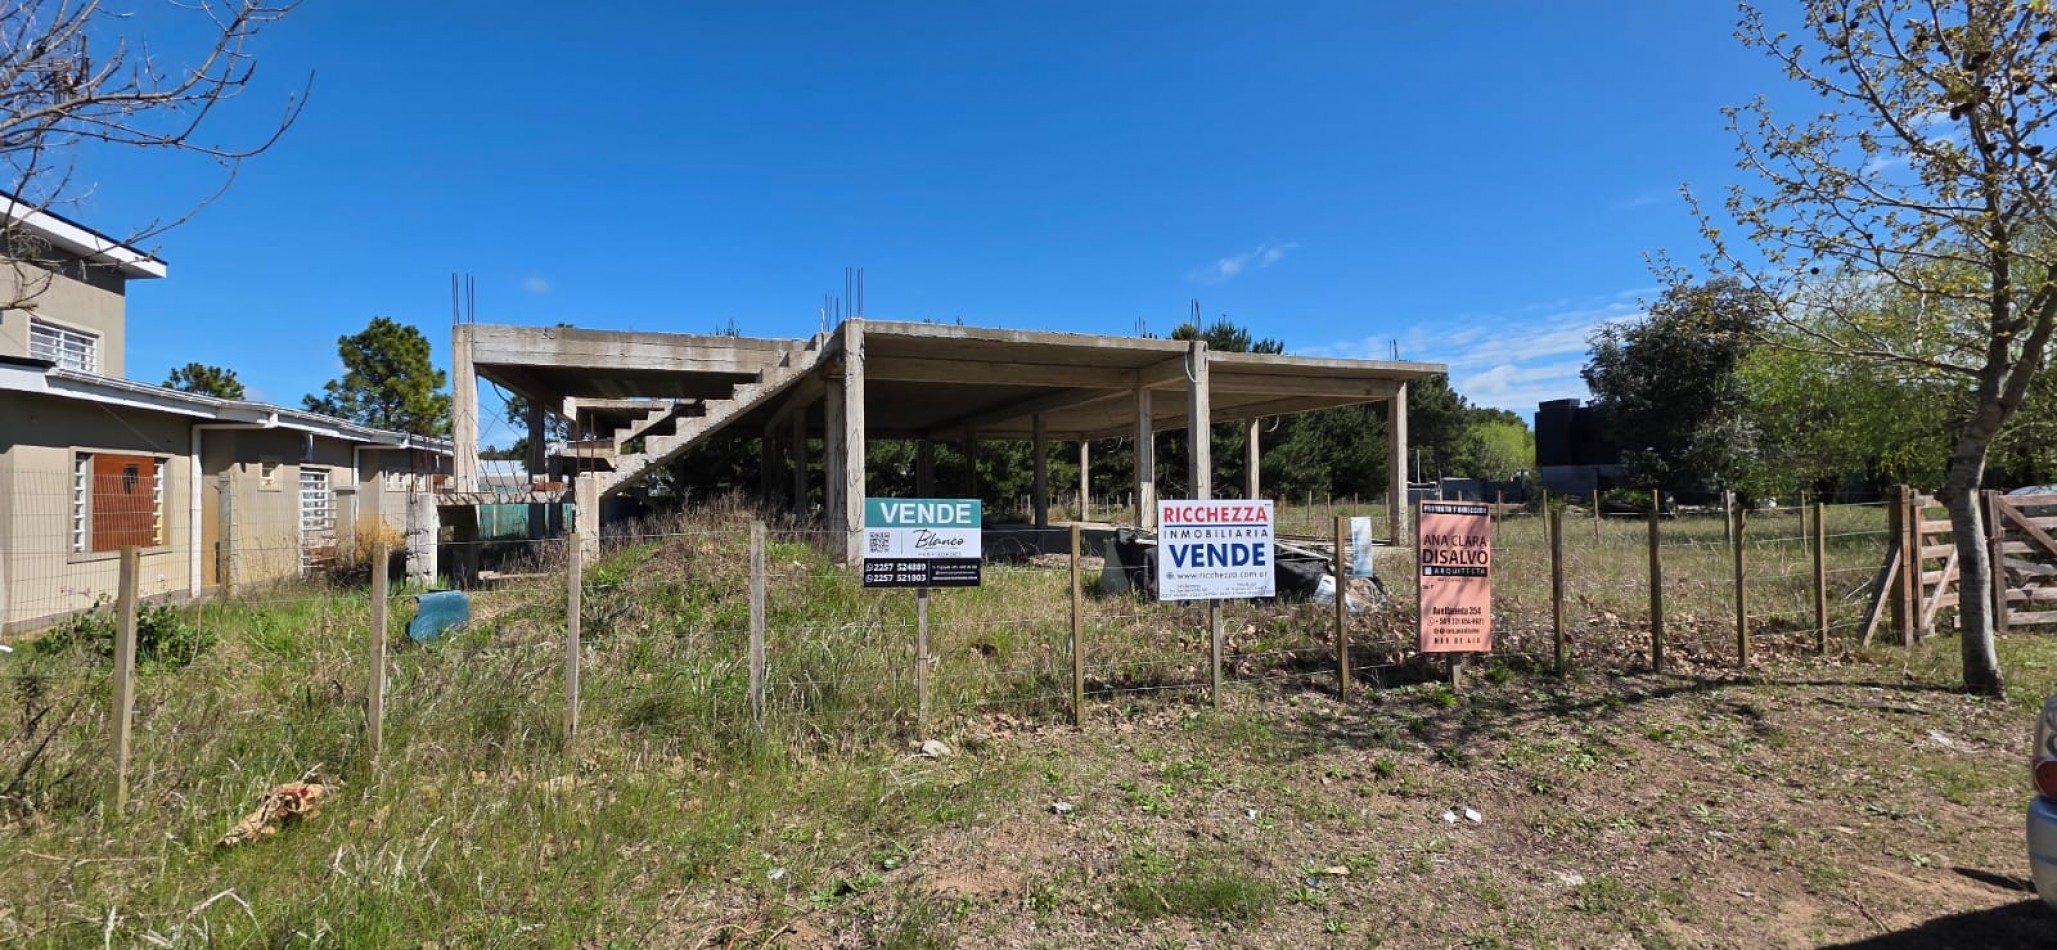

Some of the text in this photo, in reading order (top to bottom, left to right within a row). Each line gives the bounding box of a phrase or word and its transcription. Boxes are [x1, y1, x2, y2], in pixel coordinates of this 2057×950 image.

[880, 503, 972, 524] VENDE
[1163, 506, 1268, 523] RICCHEZZA
[913, 528, 964, 549] Blanco
[1163, 528, 1269, 539] INMOBILIARIA
[1423, 534, 1487, 547] ANA CLARA
[1168, 543, 1266, 568] VENDE
[1422, 549, 1489, 565] DISALVO
[873, 563, 894, 572] 2257
[873, 574, 894, 582] 2257
